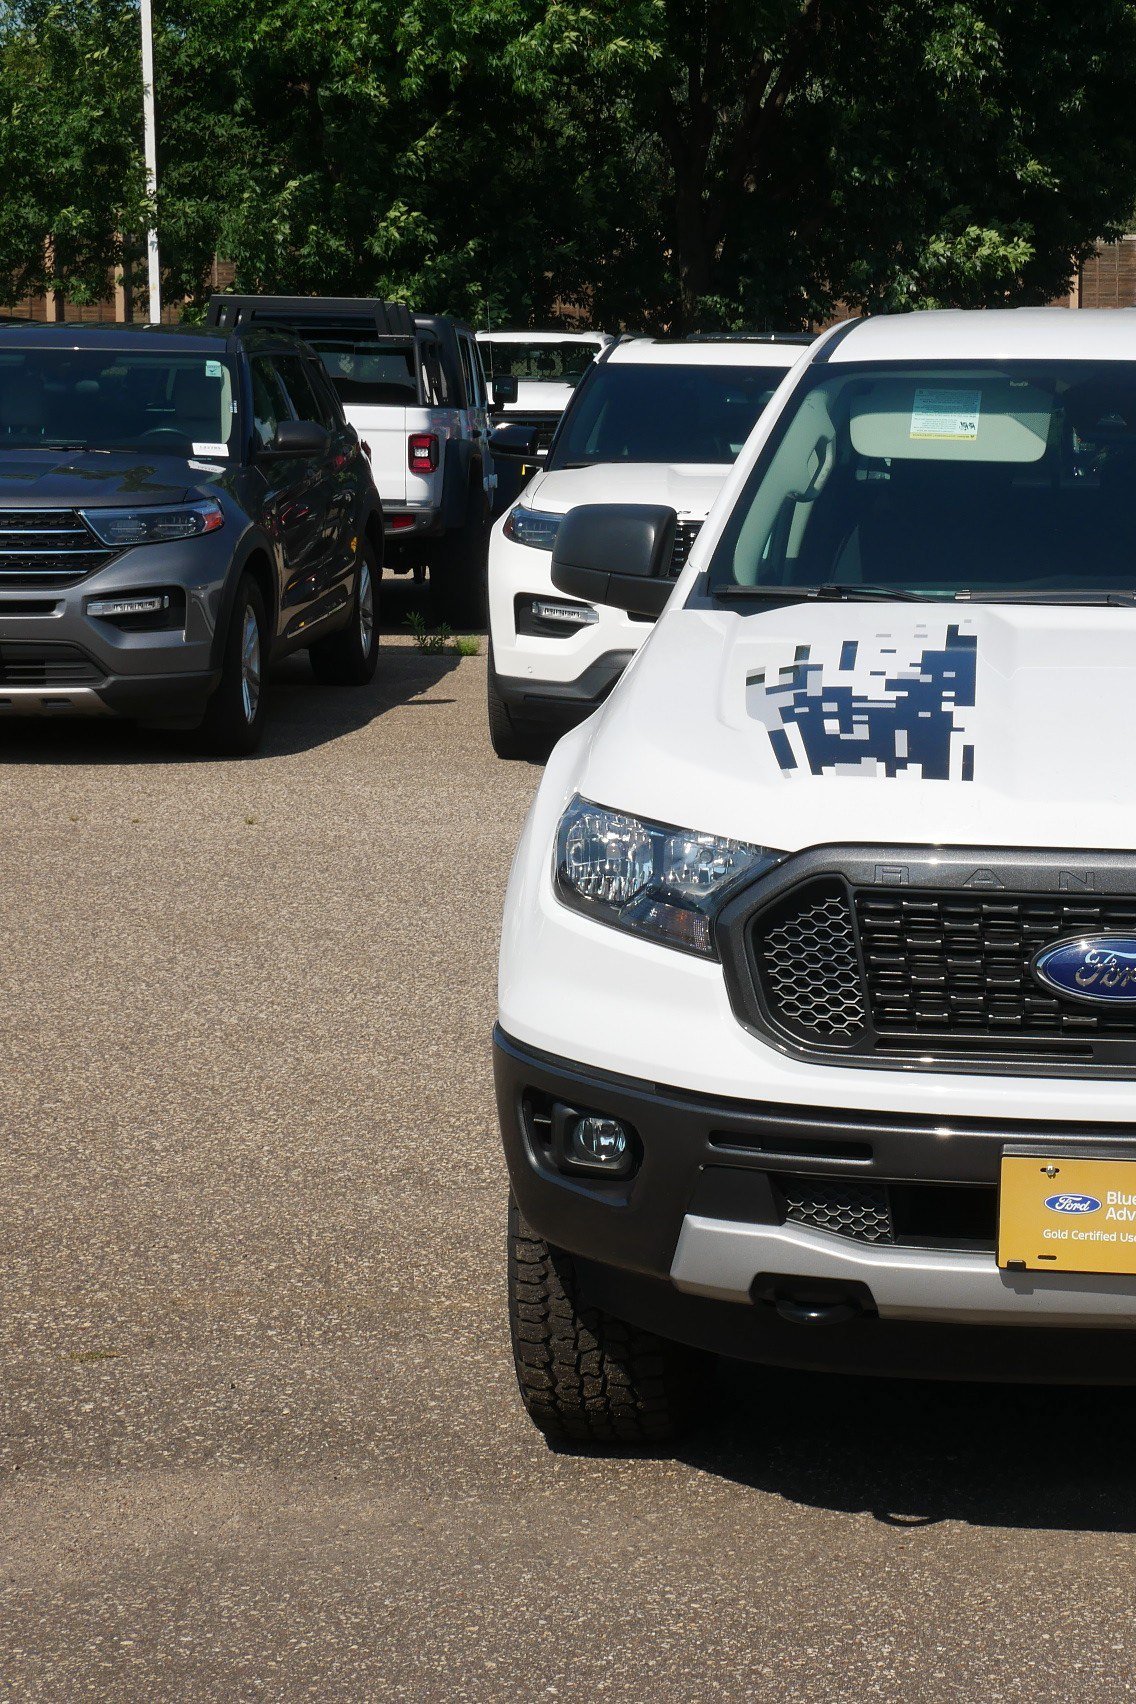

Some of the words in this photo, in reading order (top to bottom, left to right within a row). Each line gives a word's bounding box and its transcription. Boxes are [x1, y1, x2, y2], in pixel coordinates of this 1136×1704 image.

[1054, 1195, 1091, 1211] Ford
[1043, 1228, 1069, 1240] Gold
[1071, 1229, 1117, 1242] Certified
